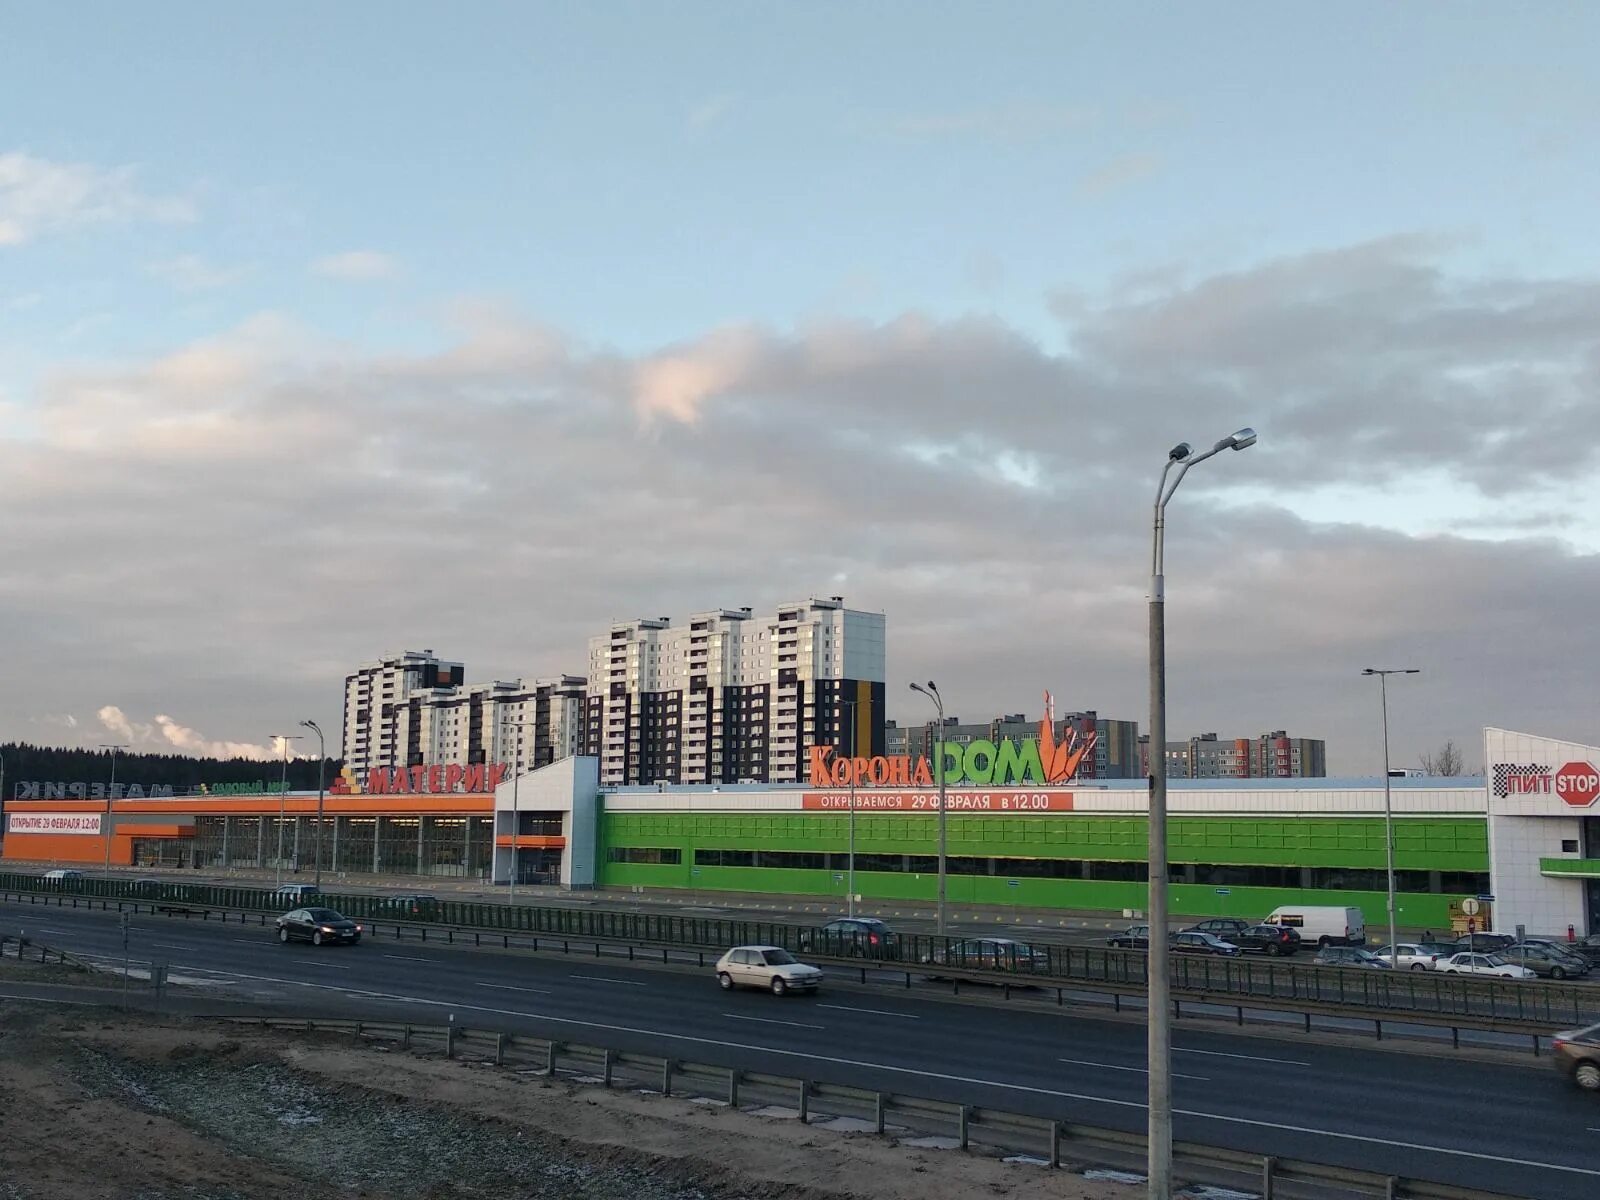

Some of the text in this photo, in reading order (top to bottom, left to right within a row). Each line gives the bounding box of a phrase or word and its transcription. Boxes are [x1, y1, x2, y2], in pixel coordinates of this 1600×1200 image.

[368, 763, 507, 793] МАТЕРИК
[1507, 775, 1598, 794] ПИТ STOP
[821, 796, 902, 807] ОТКРЫВАЕМСЯ
[911, 795, 926, 808] 29
[930, 794, 990, 809] ФВРАЛЯ
[1013, 795, 1049, 809] 12.00
[11, 818, 99, 829] ОТКРЫТИЕ 29 ФЕВРАЛЯ 12:00
